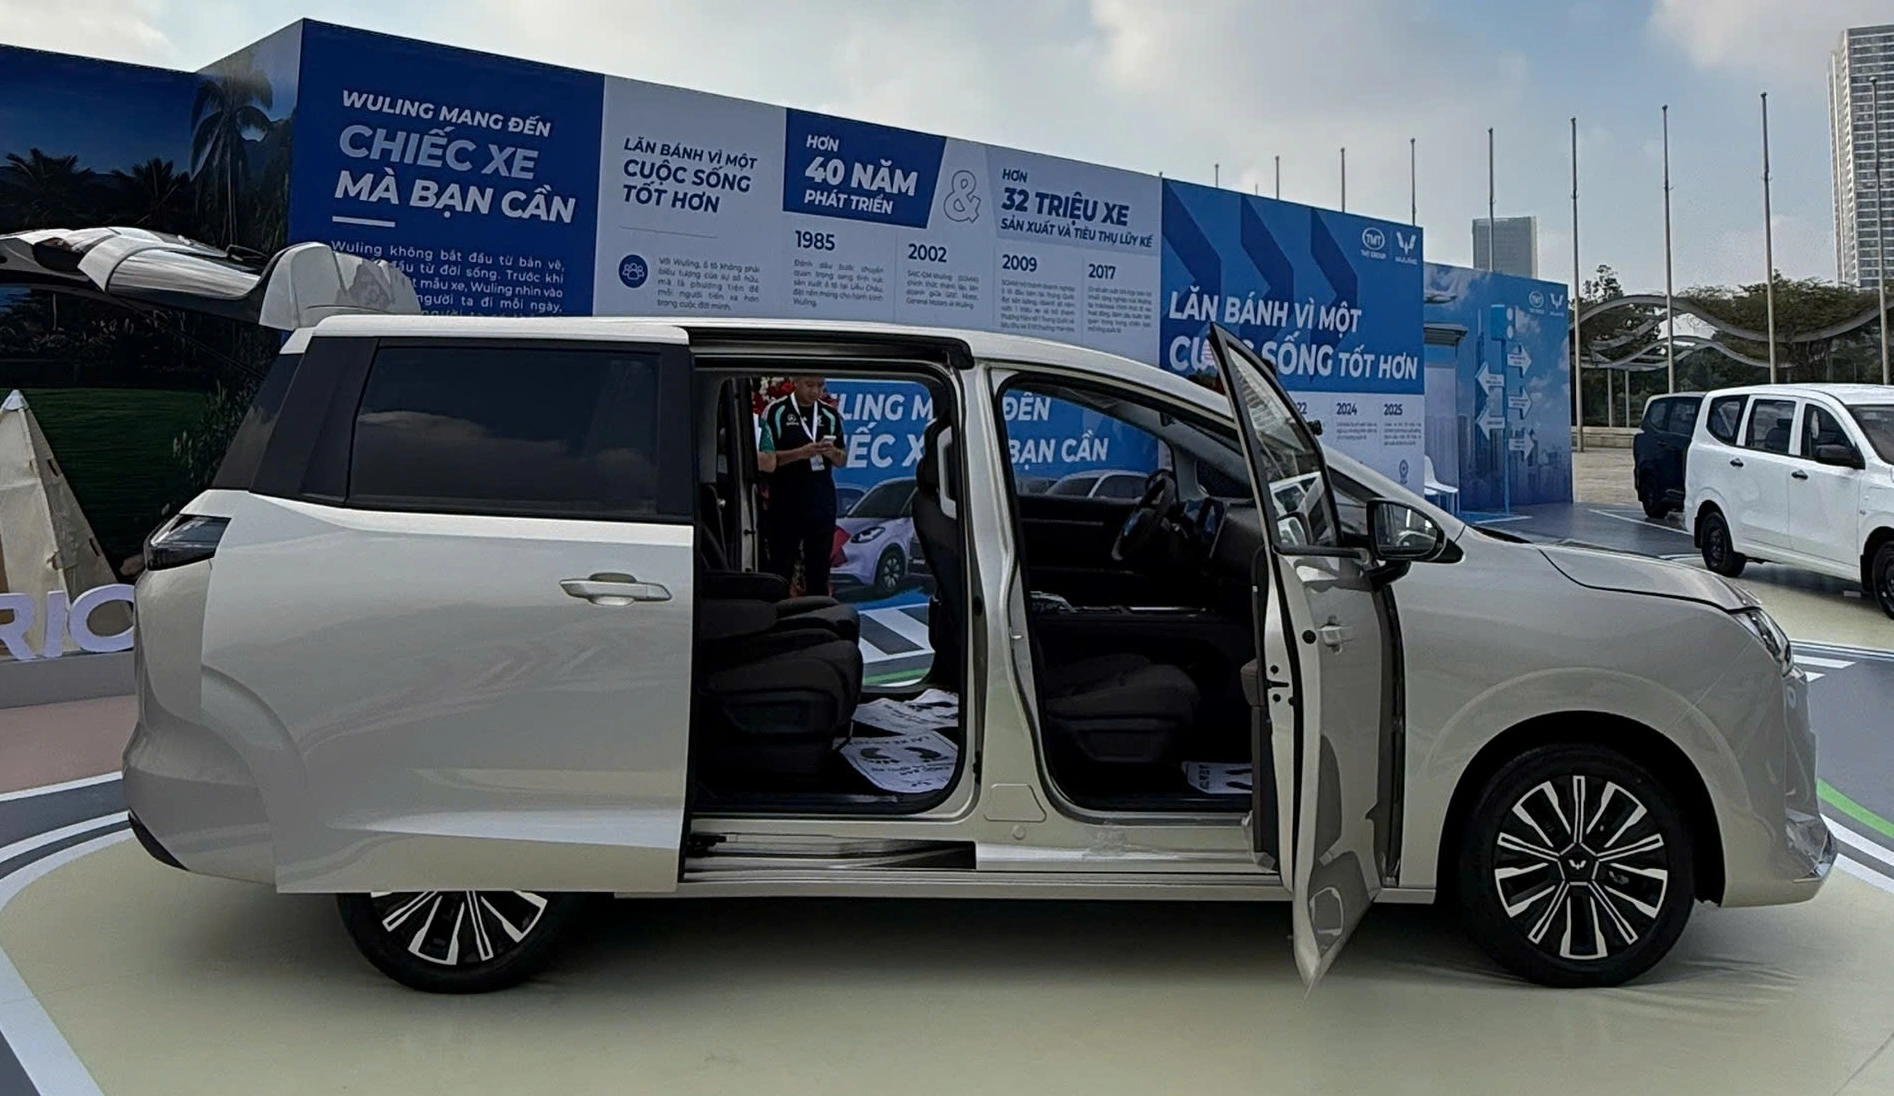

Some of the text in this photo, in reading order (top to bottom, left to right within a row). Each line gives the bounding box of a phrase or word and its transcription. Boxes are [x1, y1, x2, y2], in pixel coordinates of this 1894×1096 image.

[342, 89, 551, 137] WULING MANG ĐẾN
[339, 124, 539, 180] CHIẾC XE
[624, 136, 758, 171] LĂN BÁNH VÌ MỘT
[806, 134, 839, 152] HƠN
[624, 159, 751, 193] CUỘC SỐNG
[805, 155, 918, 197] 40 NĂM
[1002, 168, 1028, 183] HƠN
[334, 166, 576, 223] MÀ BẠN CẦN
[623, 181, 720, 213] TỐT HƠN
[804, 189, 894, 215] PHÁT TRIỂN
[943, 169, 982, 224] &
[1001, 186, 1130, 227] 32 TRIỆU XE
[795, 229, 836, 251] 1985
[1000, 215, 1025, 232] SẢN
[1026, 219, 1056, 236] XUẤT
[1058, 222, 1071, 238] VÀ
[1073, 226, 1096, 241] TIÊU
[1098, 230, 1118, 246] THỤ
[331, 240, 382, 257] Wuling
[390, 245, 433, 261] không
[907, 243, 948, 263] 2002
[1002, 253, 1038, 273] 2009
[506, 269, 541, 282] Trước
[545, 272, 564, 284] khi
[1087, 263, 1117, 280] 2017
[461, 296, 474, 307] ta
[480, 296, 493, 308] đi
[470, 281, 513, 297] Wuling
[543, 287, 563, 298] vào
[1168, 285, 1219, 322] LĂN
[1223, 291, 1289, 329] BÁNH
[1293, 297, 1315, 329] VÌ
[1318, 302, 1362, 338] MỘT
[1262, 331, 1335, 376] SỐNG
[1338, 344, 1375, 378] TỐT
[1378, 351, 1418, 380] HƠN
[1336, 402, 1358, 415] 2024
[1383, 403, 1403, 416] 2025
[1008, 438, 1056, 470] BẠN
[1061, 429, 1109, 463] CẦN
